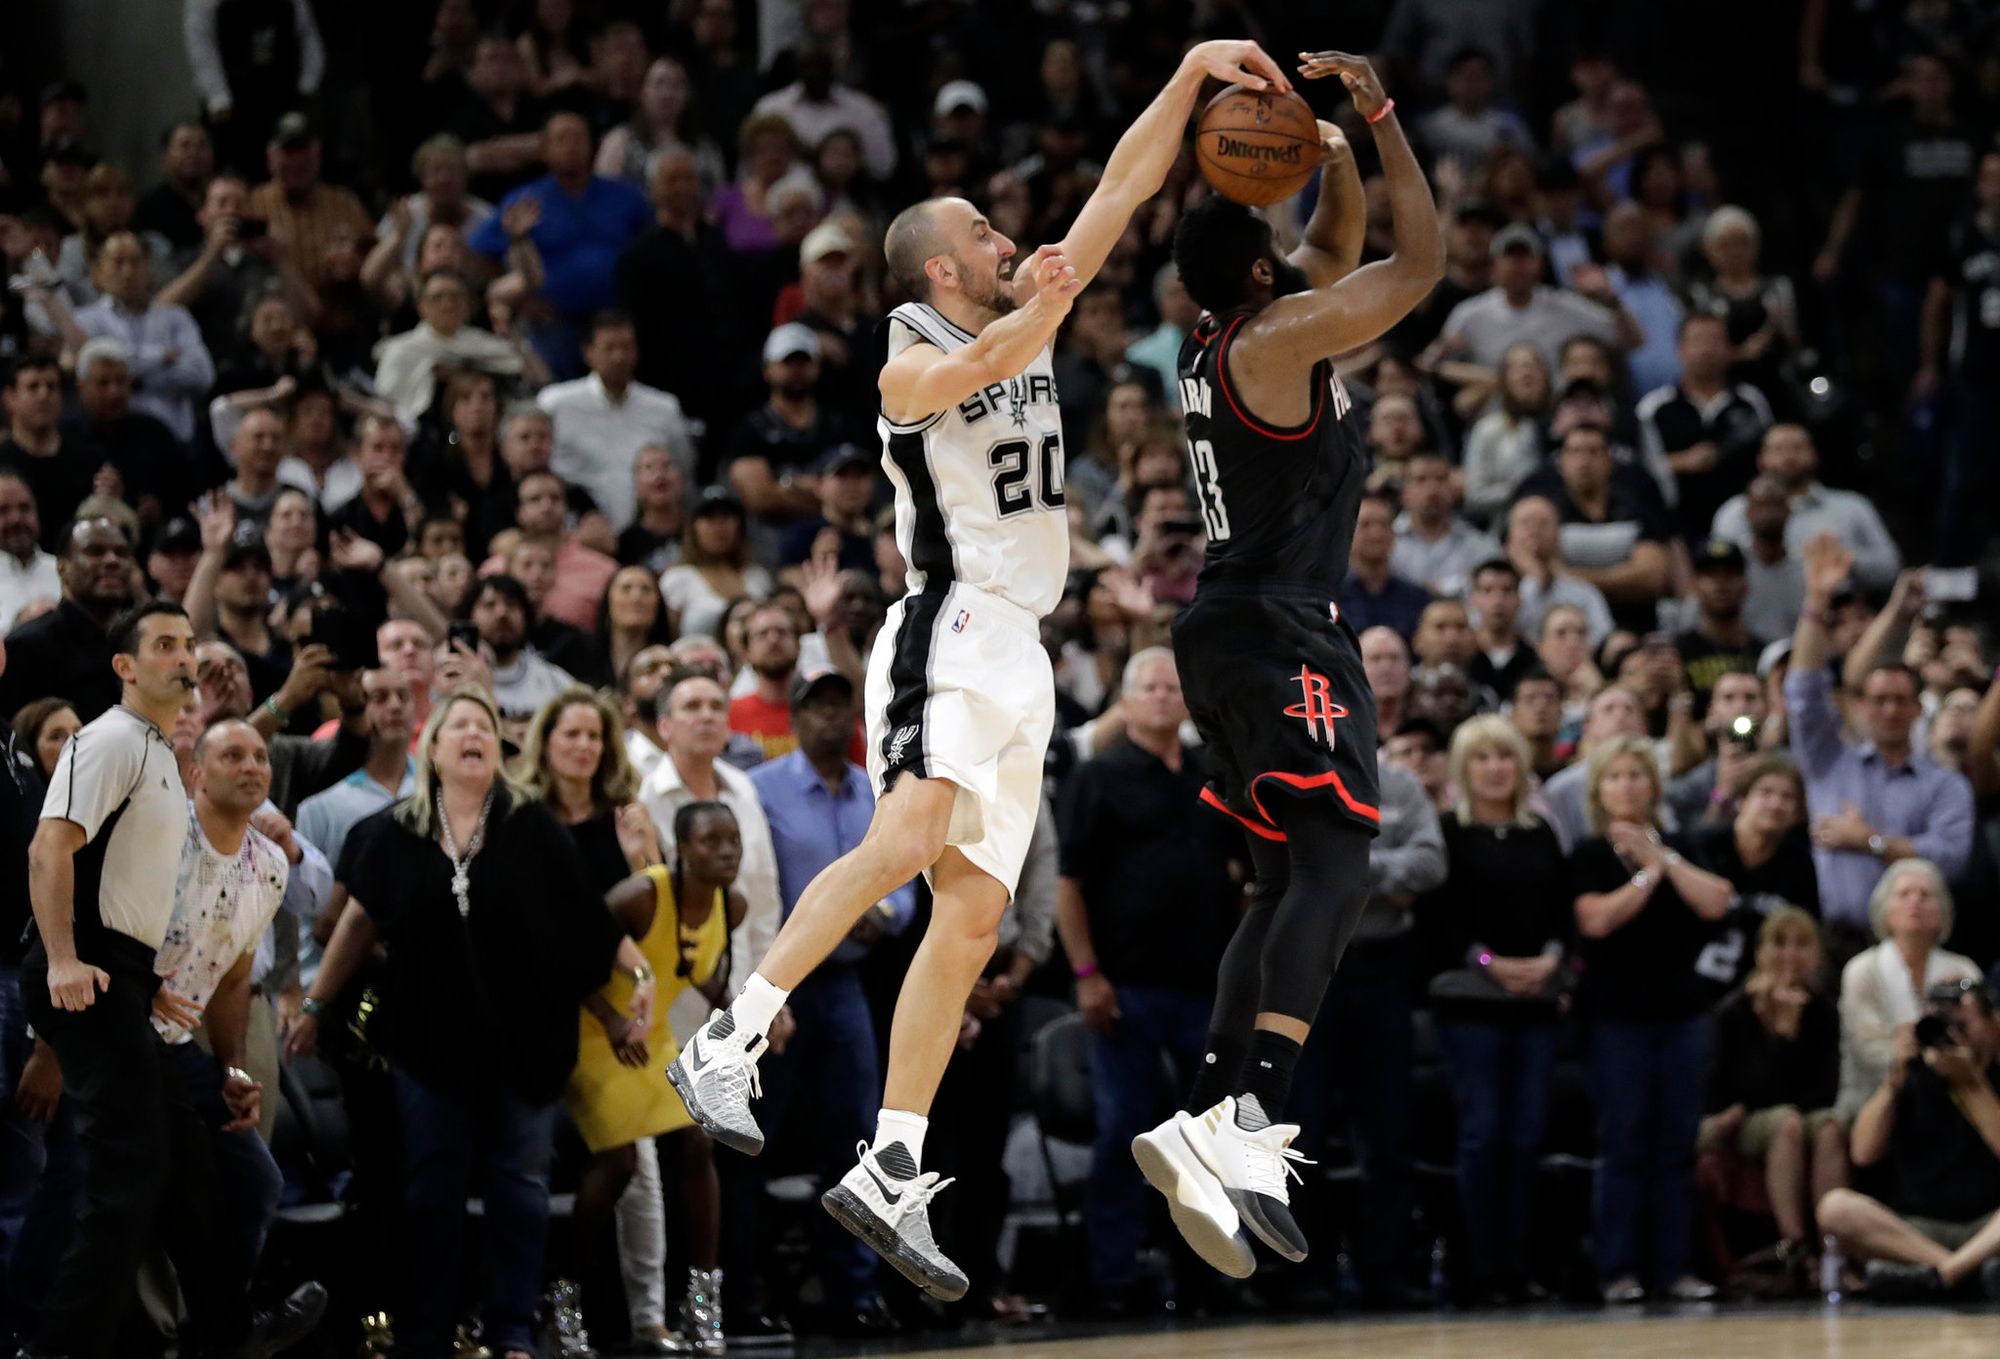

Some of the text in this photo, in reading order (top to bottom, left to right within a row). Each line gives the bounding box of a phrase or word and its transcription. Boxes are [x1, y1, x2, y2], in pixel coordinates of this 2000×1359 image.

[1217, 136, 1303, 165] SPALDING
[957, 374, 1058, 425] SPUR
[987, 431, 1065, 520] 20
